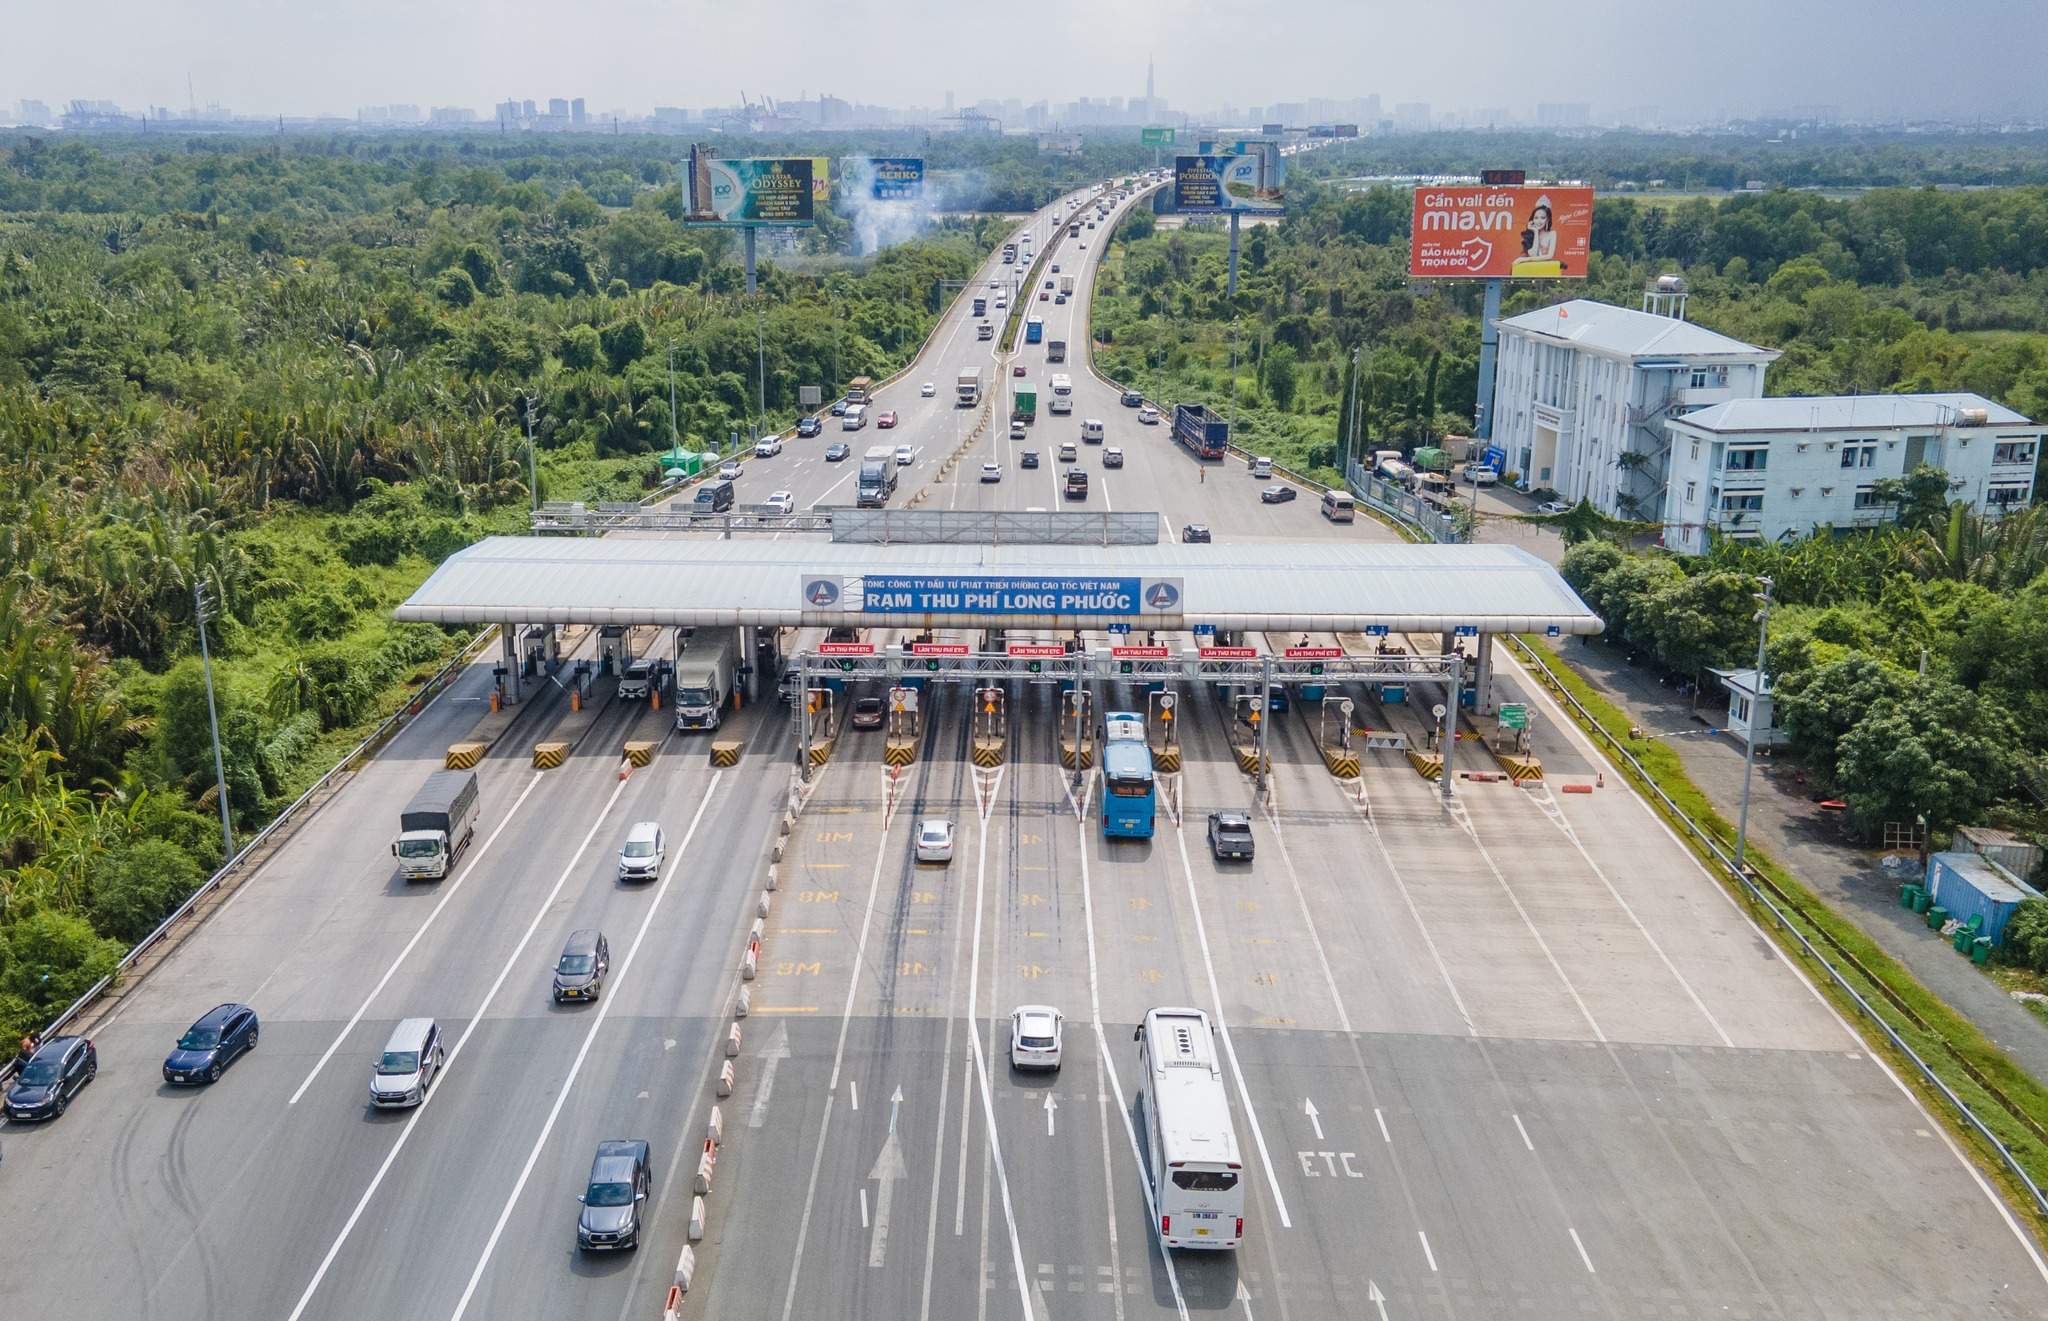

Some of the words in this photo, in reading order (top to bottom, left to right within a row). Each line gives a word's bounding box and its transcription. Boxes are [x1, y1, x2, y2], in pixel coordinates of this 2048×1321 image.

[752, 179, 801, 189] ODYSSEY
[1458, 193, 1482, 207] vali
[1486, 193, 1514, 207] đến
[1422, 210, 1513, 230] mia.vn
[914, 580, 925, 588] TY
[1042, 582, 1058, 590] CAO
[1100, 581, 1120, 590] NAM
[920, 594, 959, 608] THU
[965, 591, 998, 608] PHÍ
[1004, 594, 1056, 609] LONG
[1061, 591, 1130, 609] PHƯỚC
[1298, 1151, 1364, 1178] ETC
